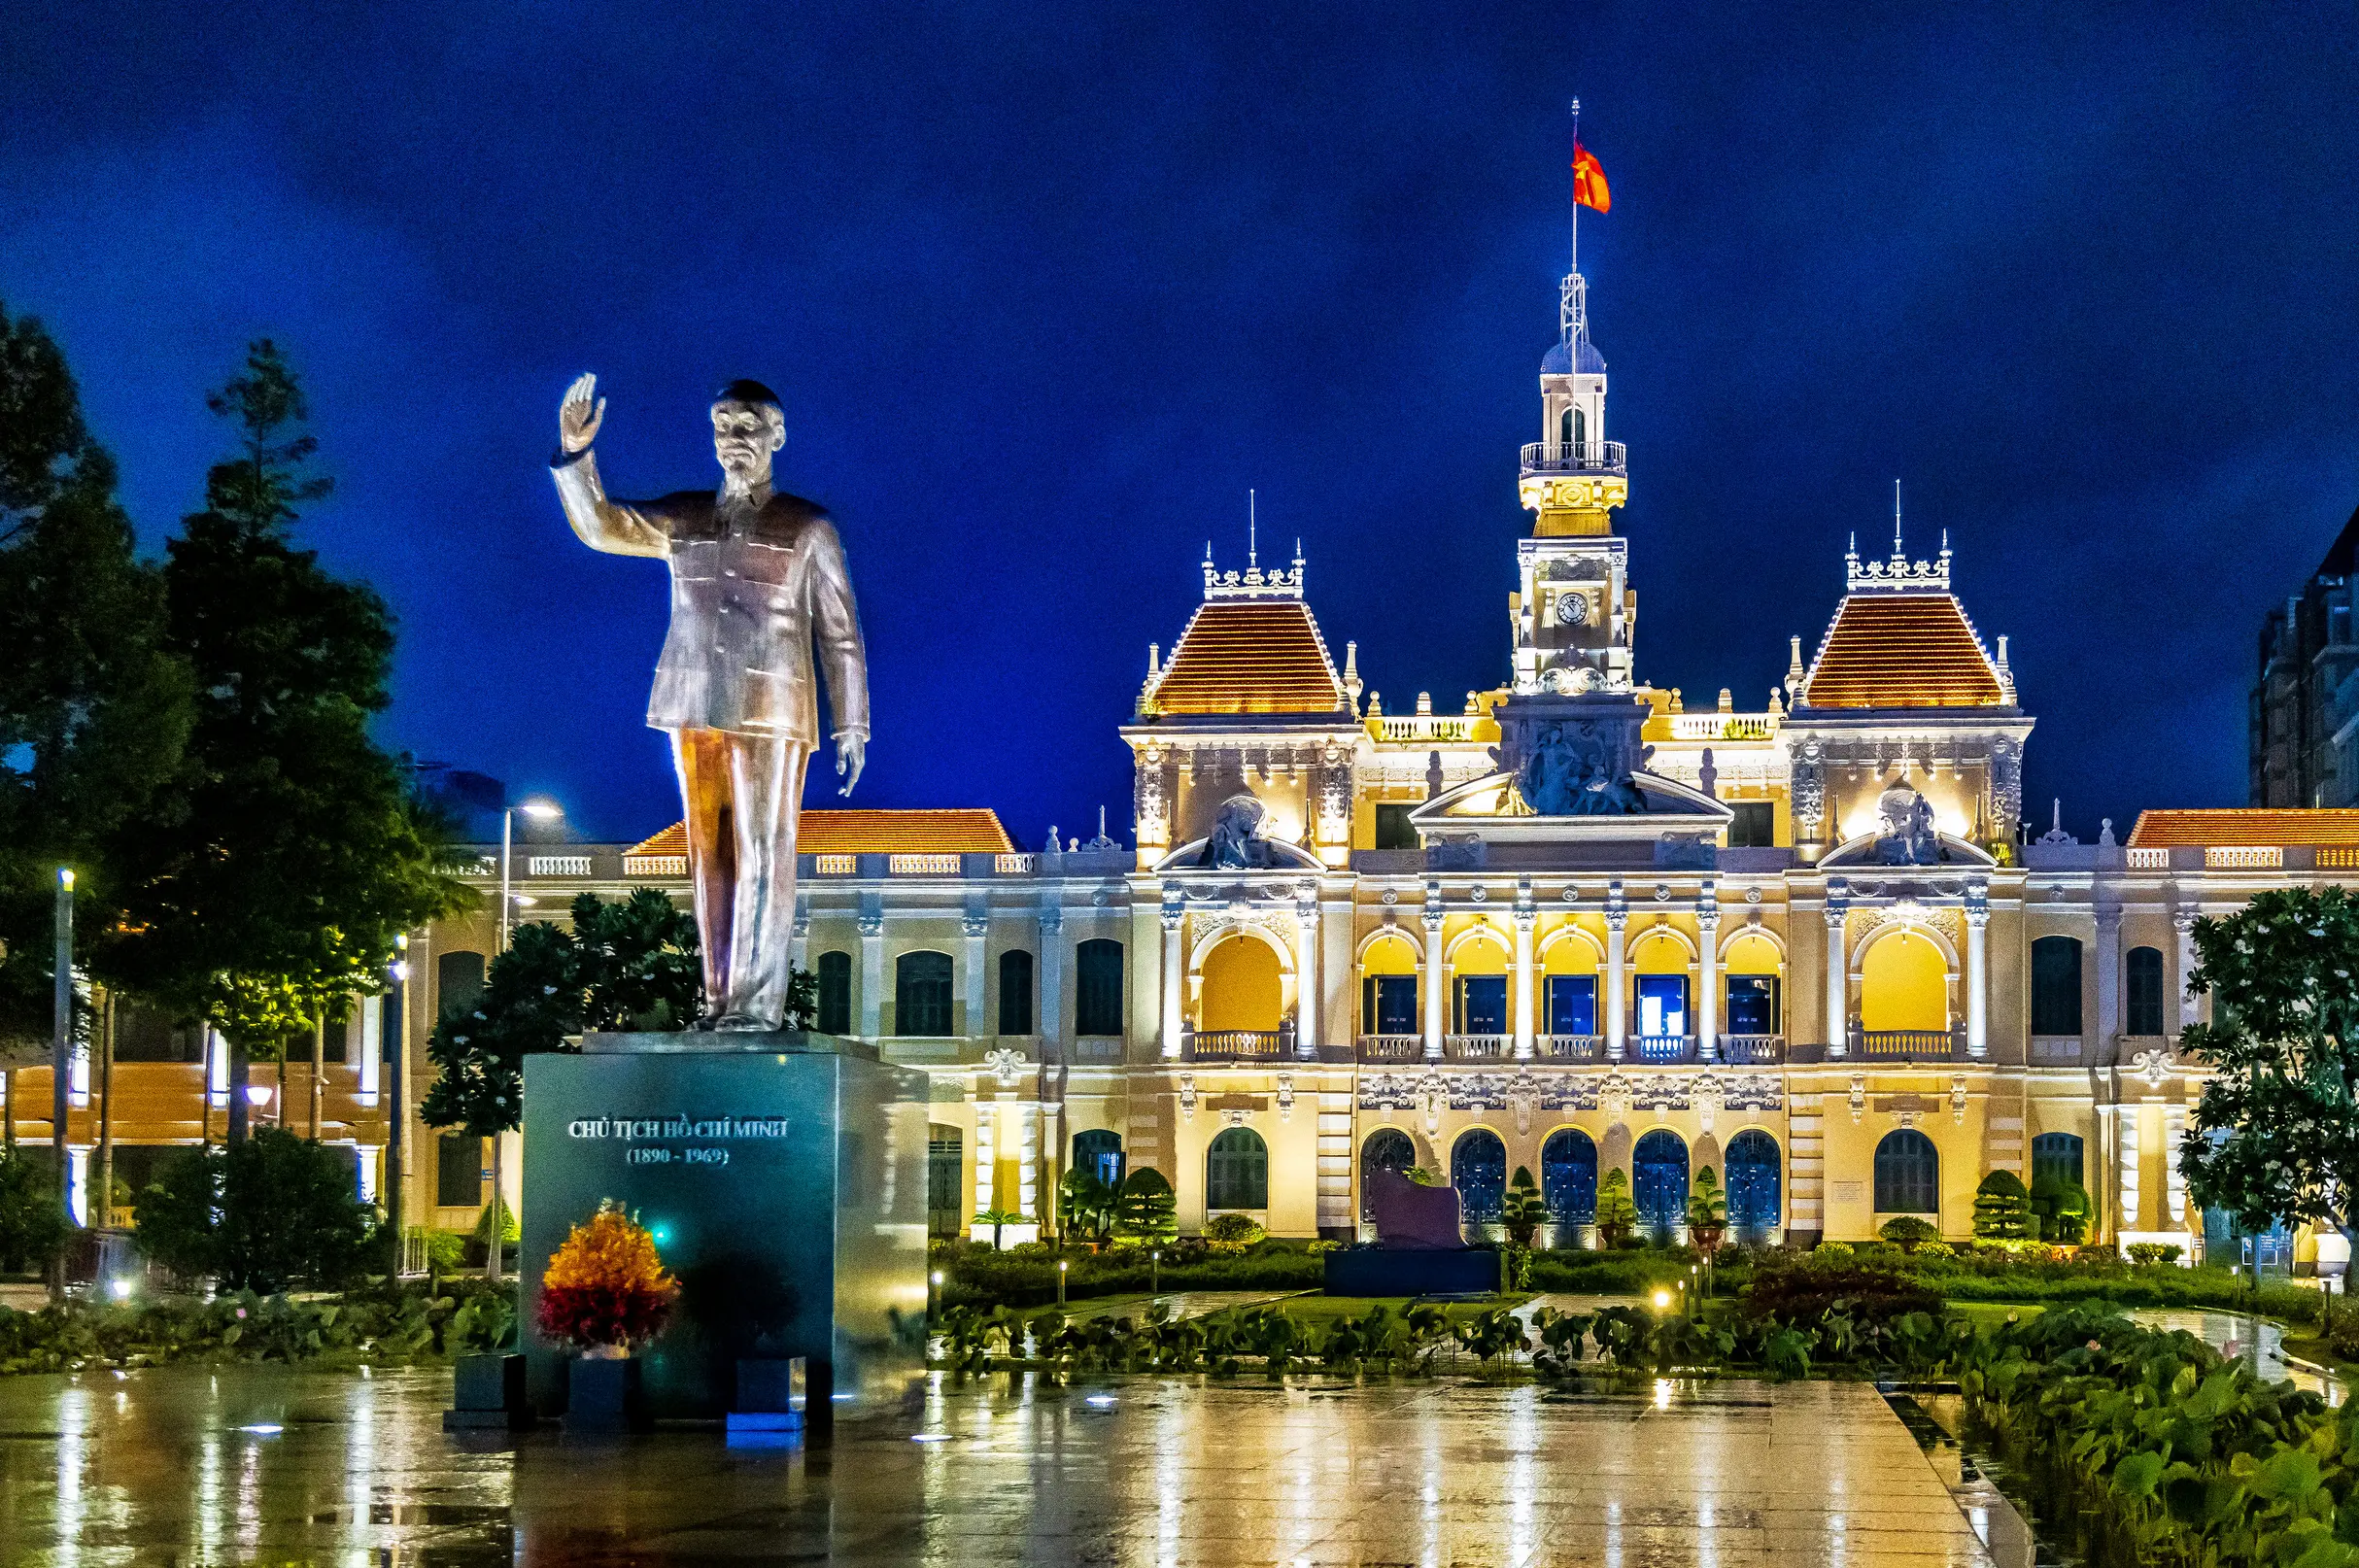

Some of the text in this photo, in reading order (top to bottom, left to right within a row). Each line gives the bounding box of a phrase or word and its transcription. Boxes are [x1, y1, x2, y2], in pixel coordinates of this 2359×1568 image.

[568, 1112, 788, 1141] CHỦ TỊCH HỒ CHÍ MINH
[627, 1147, 671, 1166] (1890
[685, 1147, 730, 1166] 1969)
